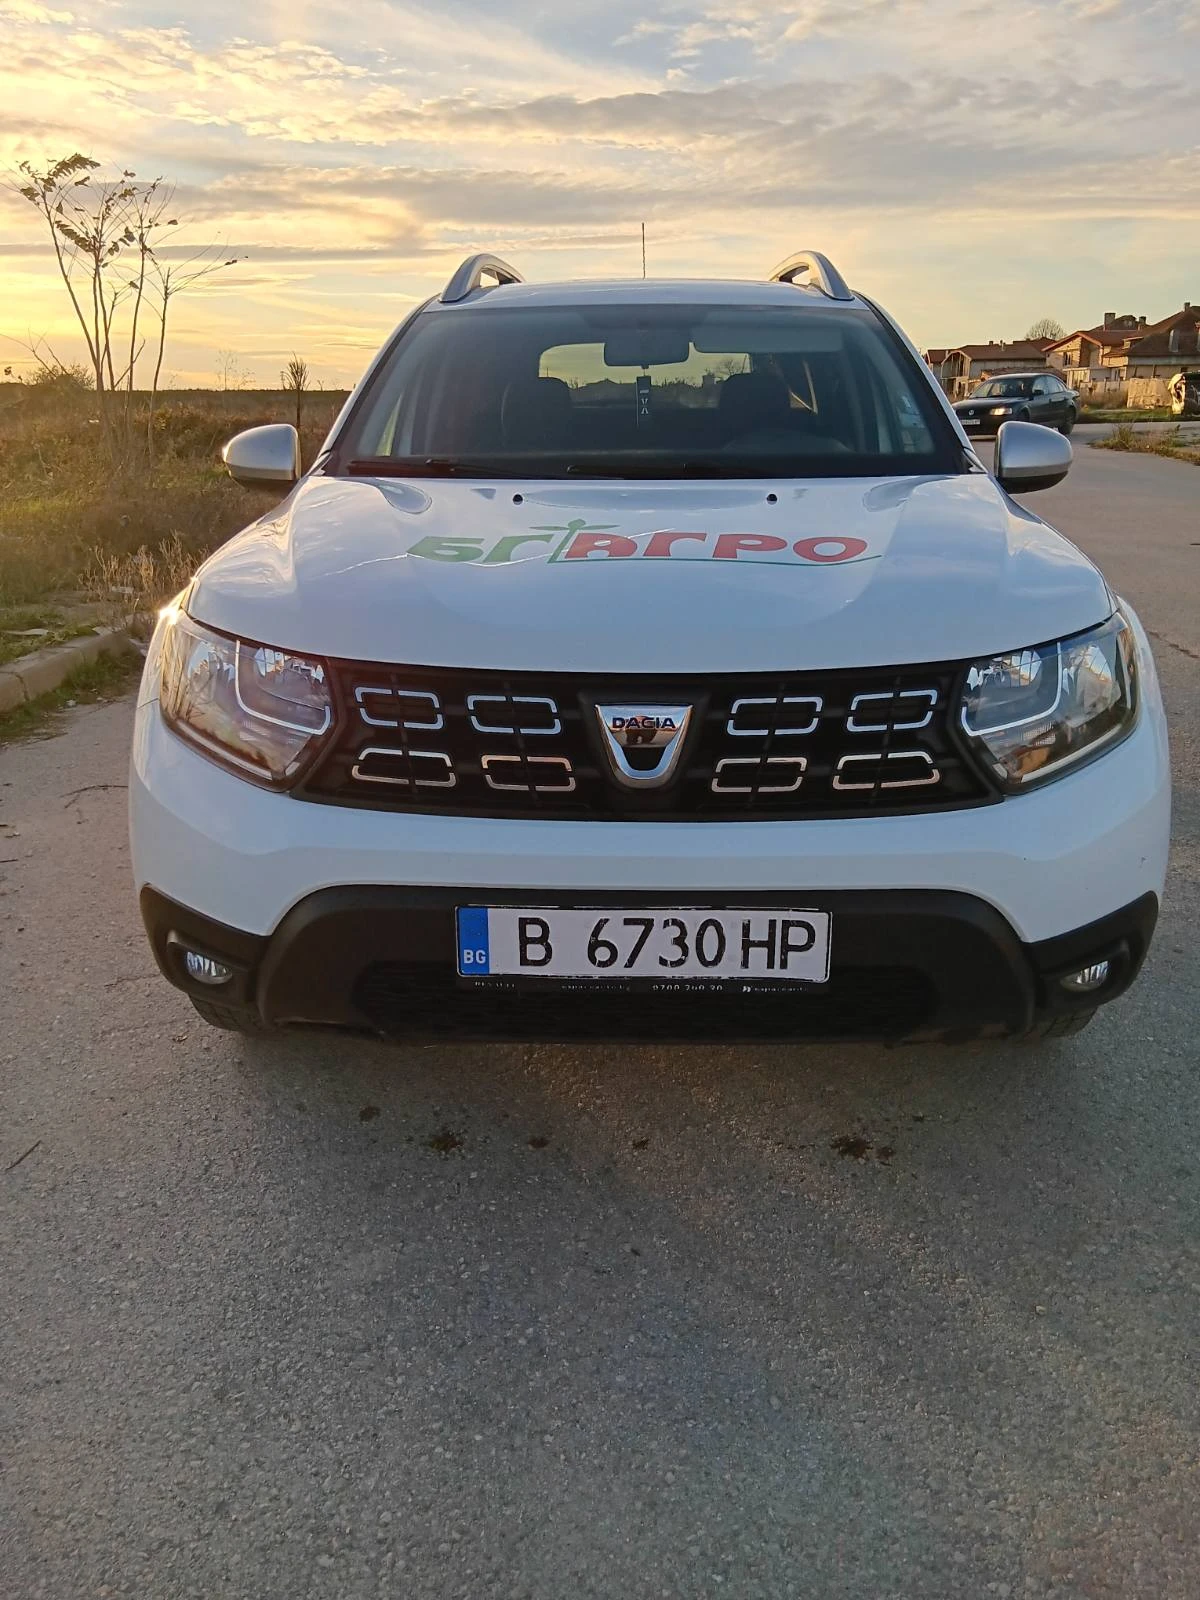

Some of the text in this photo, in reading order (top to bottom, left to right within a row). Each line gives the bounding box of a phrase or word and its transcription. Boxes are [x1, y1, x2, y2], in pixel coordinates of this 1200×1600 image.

[612, 717, 676, 729] DACIA
[517, 917, 553, 967] B
[463, 950, 487, 964] BG
